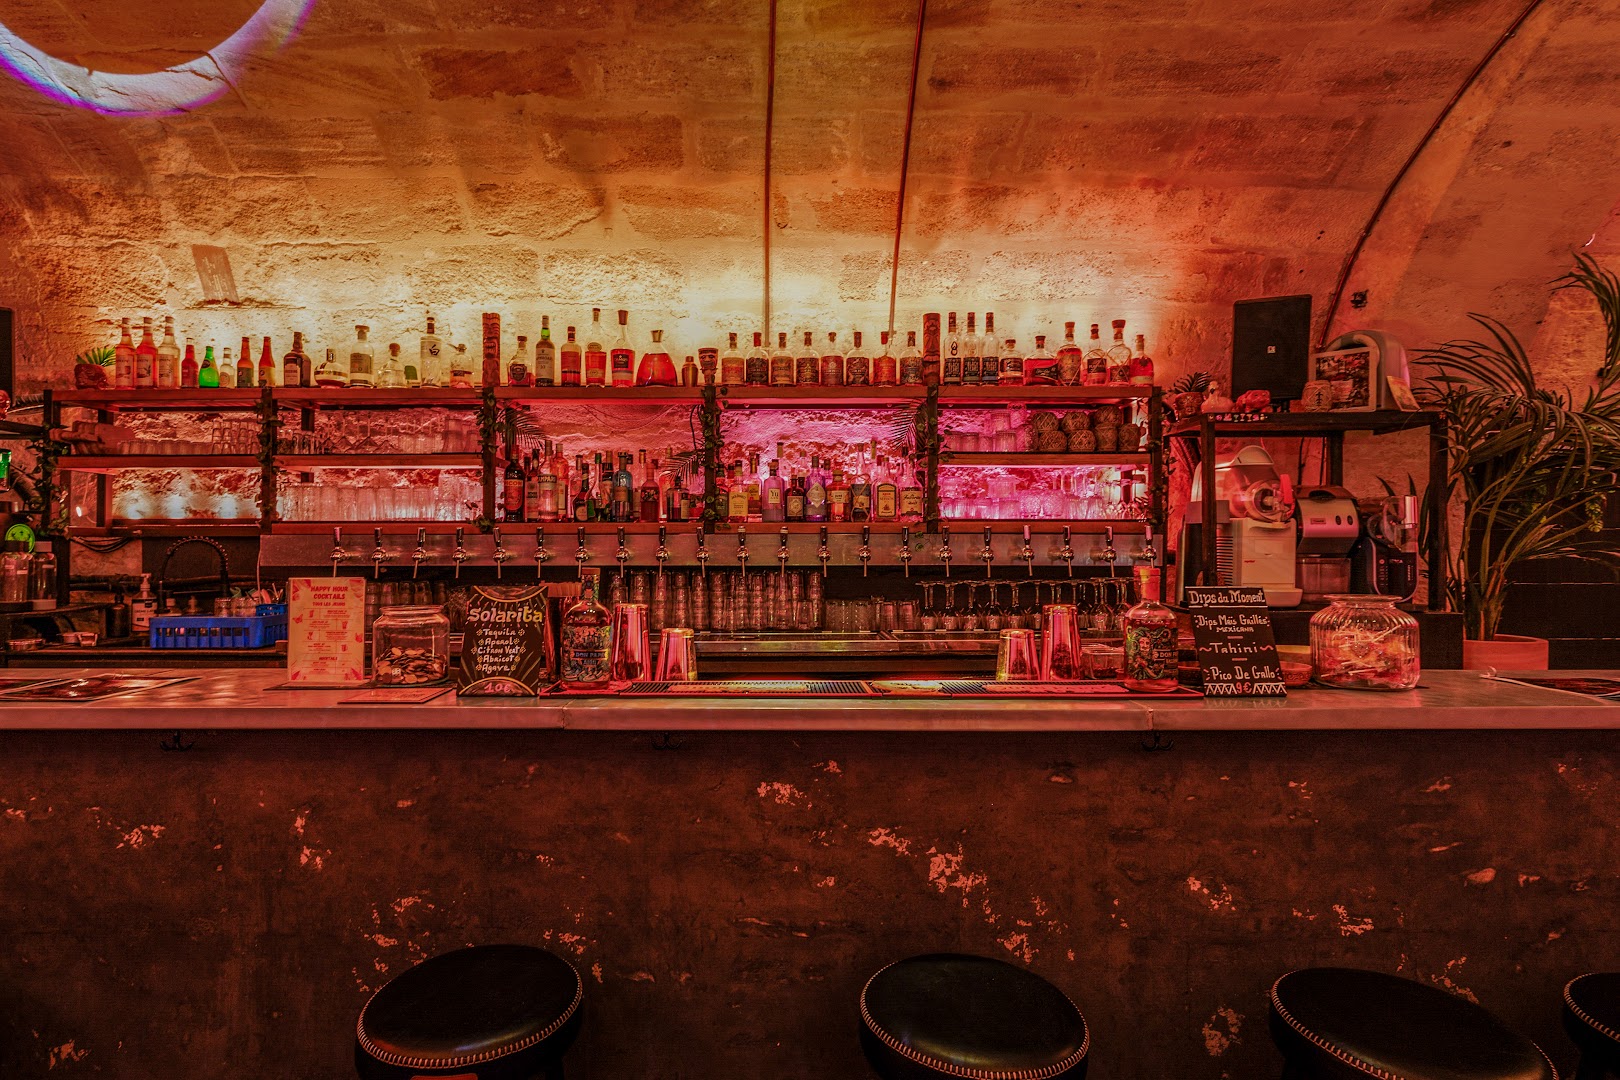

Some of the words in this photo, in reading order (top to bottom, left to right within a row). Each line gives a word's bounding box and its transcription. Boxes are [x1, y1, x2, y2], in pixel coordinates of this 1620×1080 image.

[1188, 590, 1217, 607] Dips
[1218, 592, 1230, 603] du
[1228, 590, 1266, 603] Moment
[467, 606, 543, 623] Solarita
[1197, 614, 1218, 630] Dips
[1239, 614, 1268, 625] Grillés
[483, 628, 516, 639] Tequila
[484, 637, 514, 648] Aperol
[1209, 642, 1258, 653] Tahini
[477, 646, 504, 654] Citron
[505, 646, 521, 654] Vert
[483, 655, 515, 663] Abricot
[482, 663, 510, 674] Agave
[1209, 666, 1232, 680] Pico
[1234, 666, 1251, 680] De
[1251, 665, 1276, 679] Gallo
